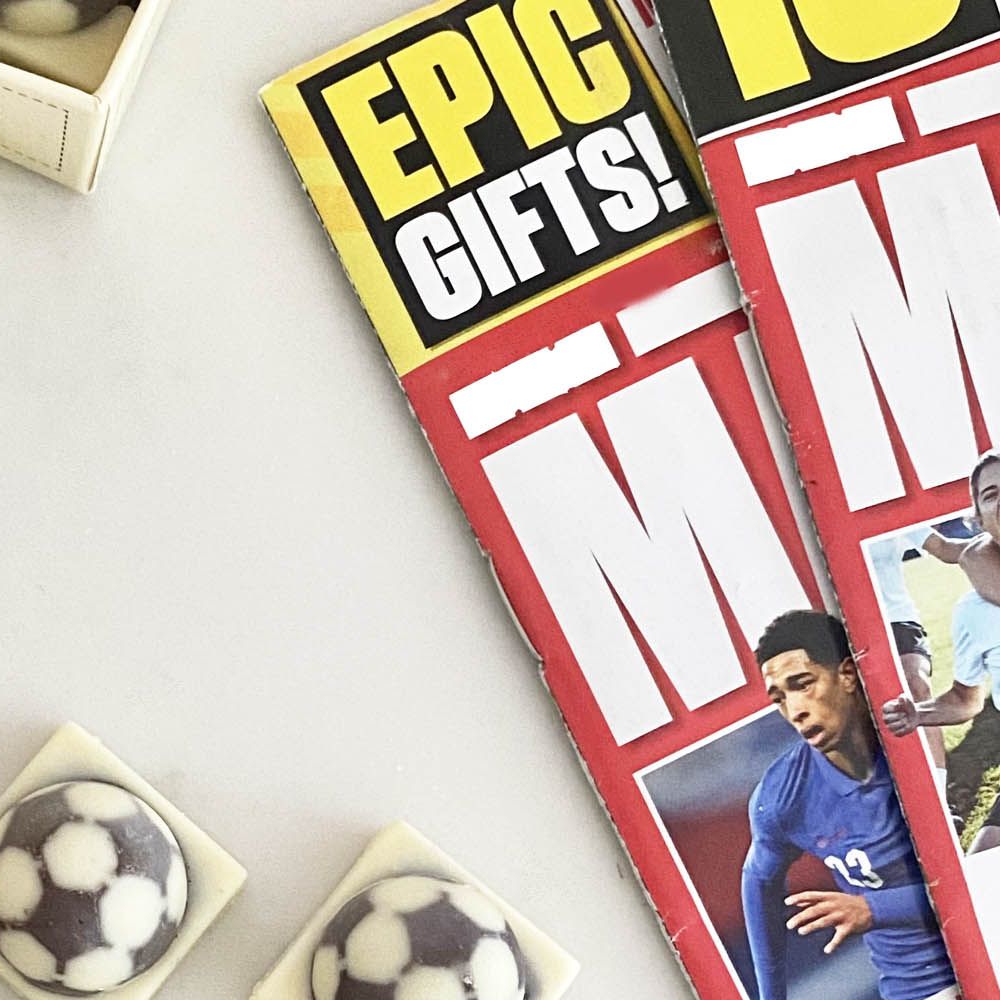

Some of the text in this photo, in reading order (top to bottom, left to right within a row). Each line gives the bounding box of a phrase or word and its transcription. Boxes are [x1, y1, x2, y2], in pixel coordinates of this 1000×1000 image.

[321, 0, 631, 221] EPIC
[394, 111, 690, 321] GIFTS!
[823, 848, 884, 889] 23
